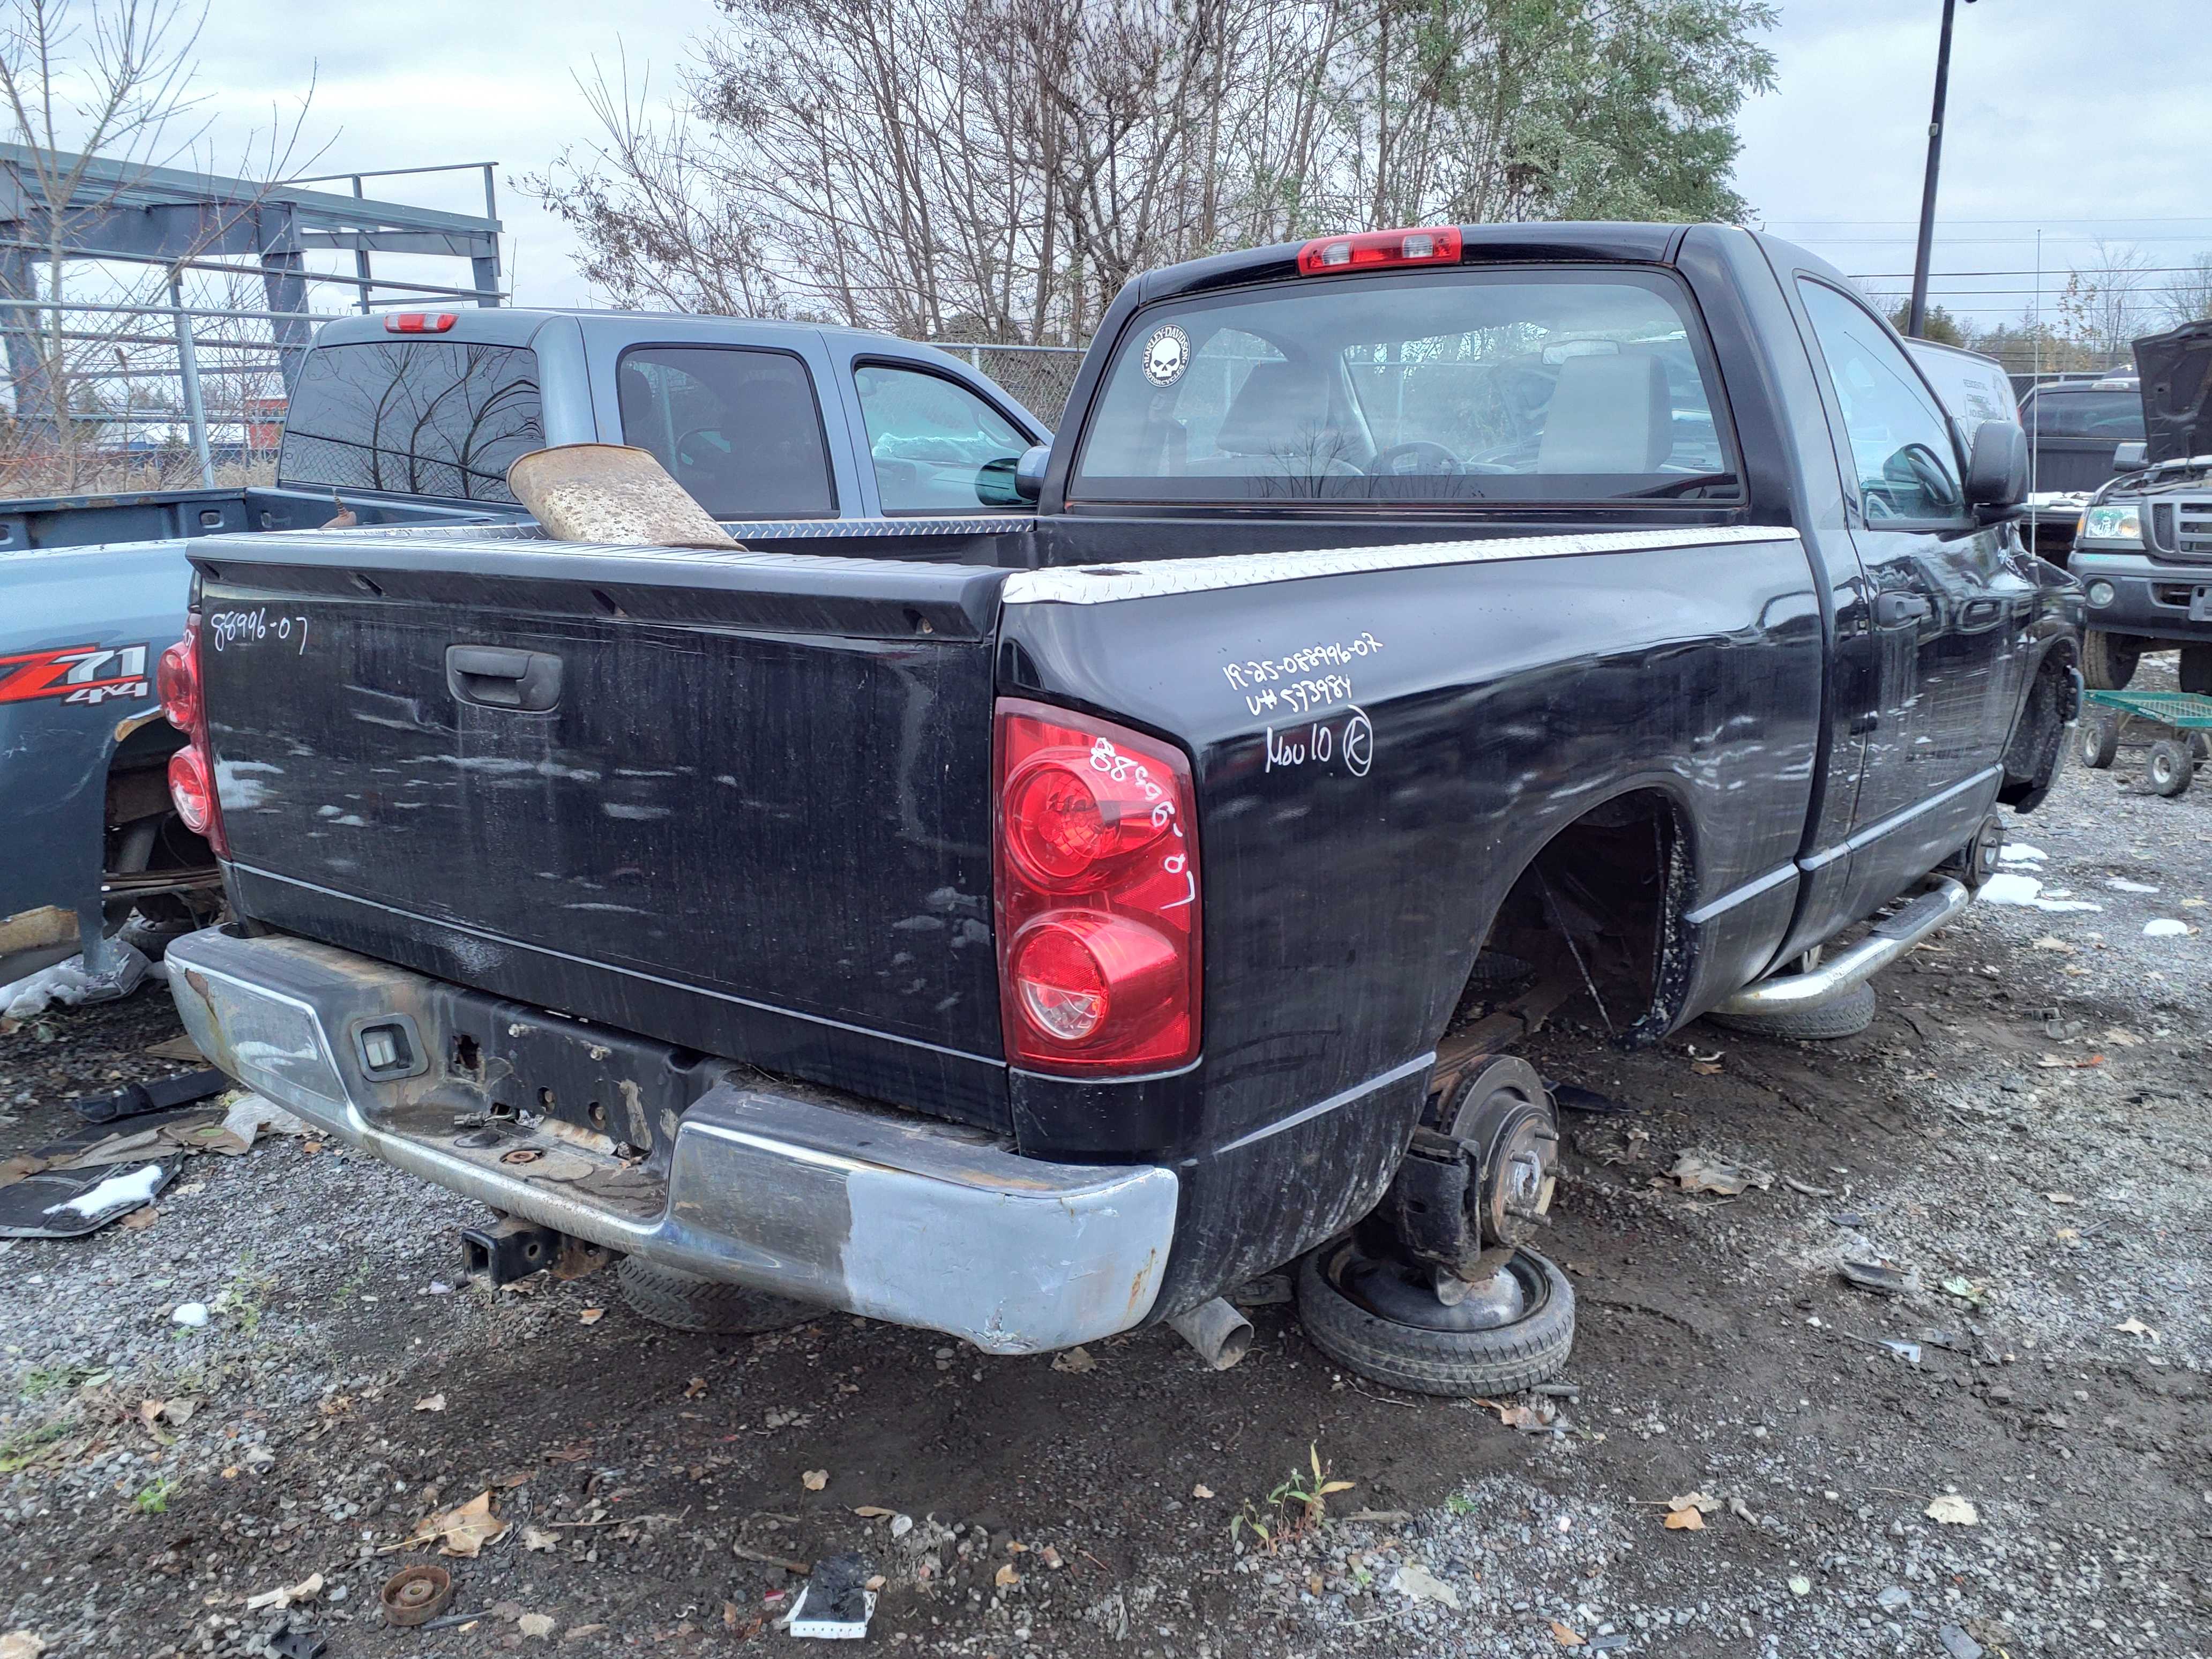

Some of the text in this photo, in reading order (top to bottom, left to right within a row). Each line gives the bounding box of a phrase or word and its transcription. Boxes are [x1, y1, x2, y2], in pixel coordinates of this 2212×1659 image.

[1144, 327, 1188, 364] HARLEY-DAVIDSON
[1145, 364, 1185, 385] MOTORCYCLES
[211, 607, 308, 655] 88996-07
[0, 642, 150, 705] Z71
